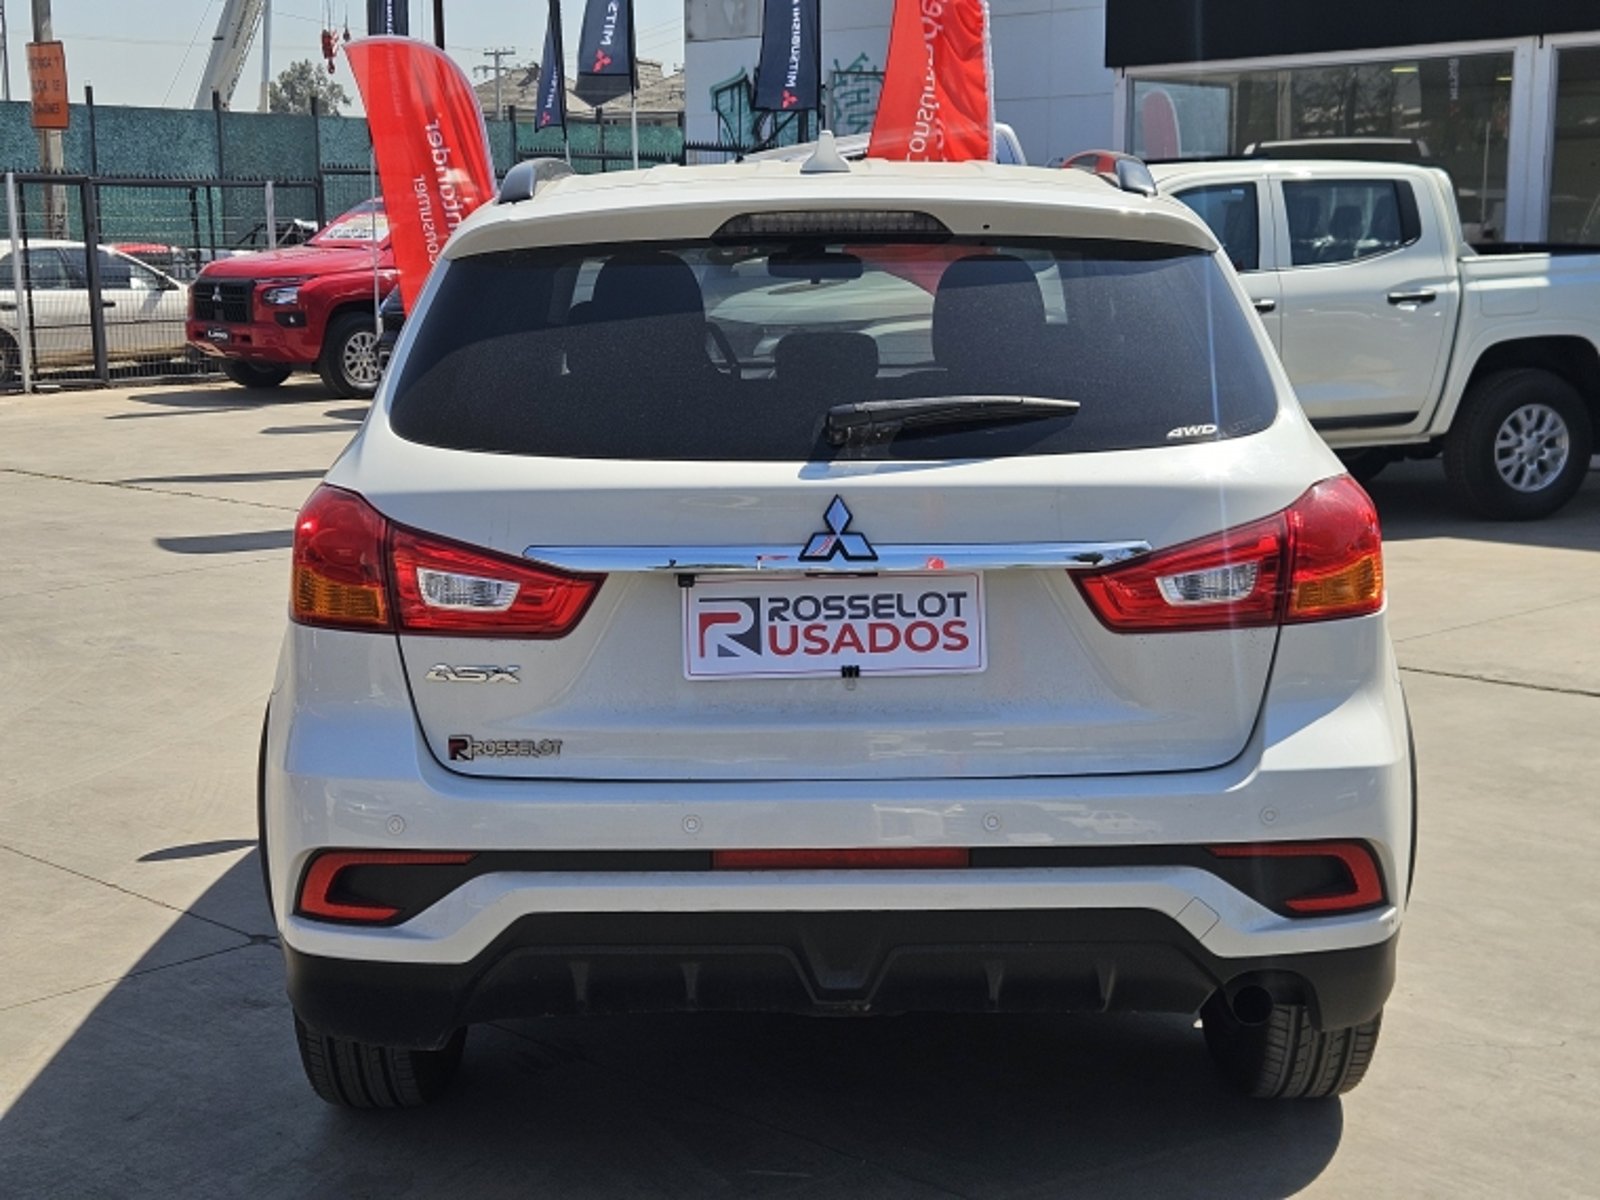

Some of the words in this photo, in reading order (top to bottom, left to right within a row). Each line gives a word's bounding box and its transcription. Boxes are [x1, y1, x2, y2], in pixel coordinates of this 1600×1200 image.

[1166, 424, 1218, 439] 4WD
[768, 591, 968, 622] ROSSELOT
[768, 620, 970, 656] USADOS
[425, 663, 521, 684] ASX
[472, 739, 562, 758] ROSSELOT
